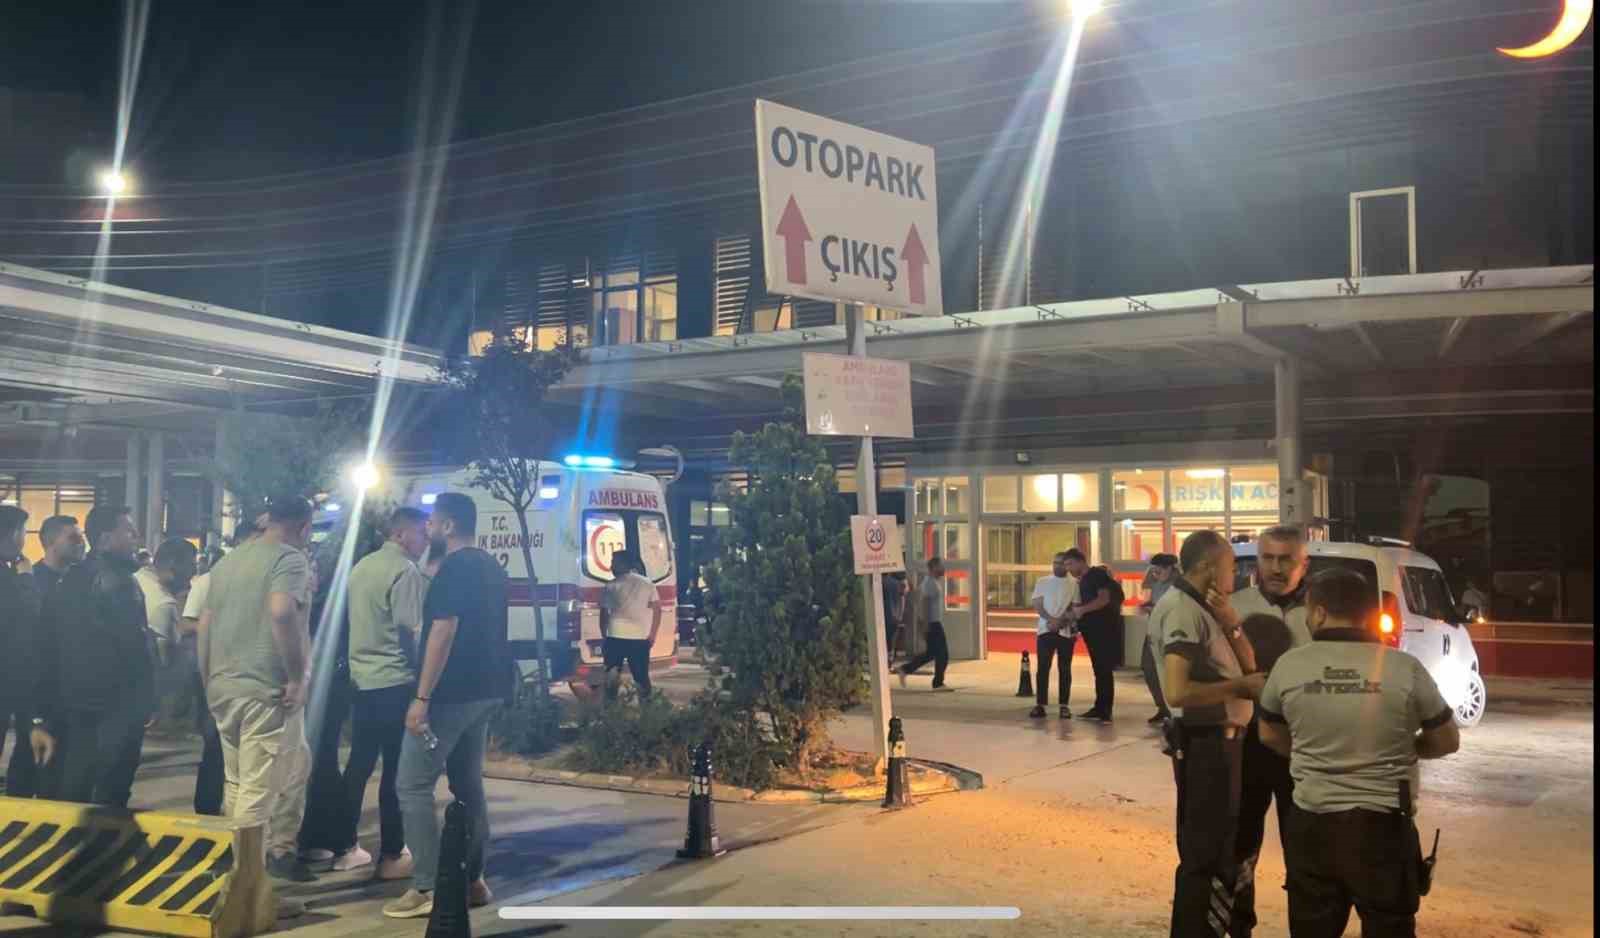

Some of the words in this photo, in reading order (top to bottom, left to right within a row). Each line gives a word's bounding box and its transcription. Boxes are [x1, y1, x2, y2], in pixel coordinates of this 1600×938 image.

[771, 126, 925, 200] OTOPARK
[821, 235, 897, 291] ÇIKIŞ
[588, 490, 657, 508] AMBULANS
[491, 516, 508, 531] T.C.
[490, 529, 544, 549] BAKAIĞI
[868, 527, 882, 544] 20
